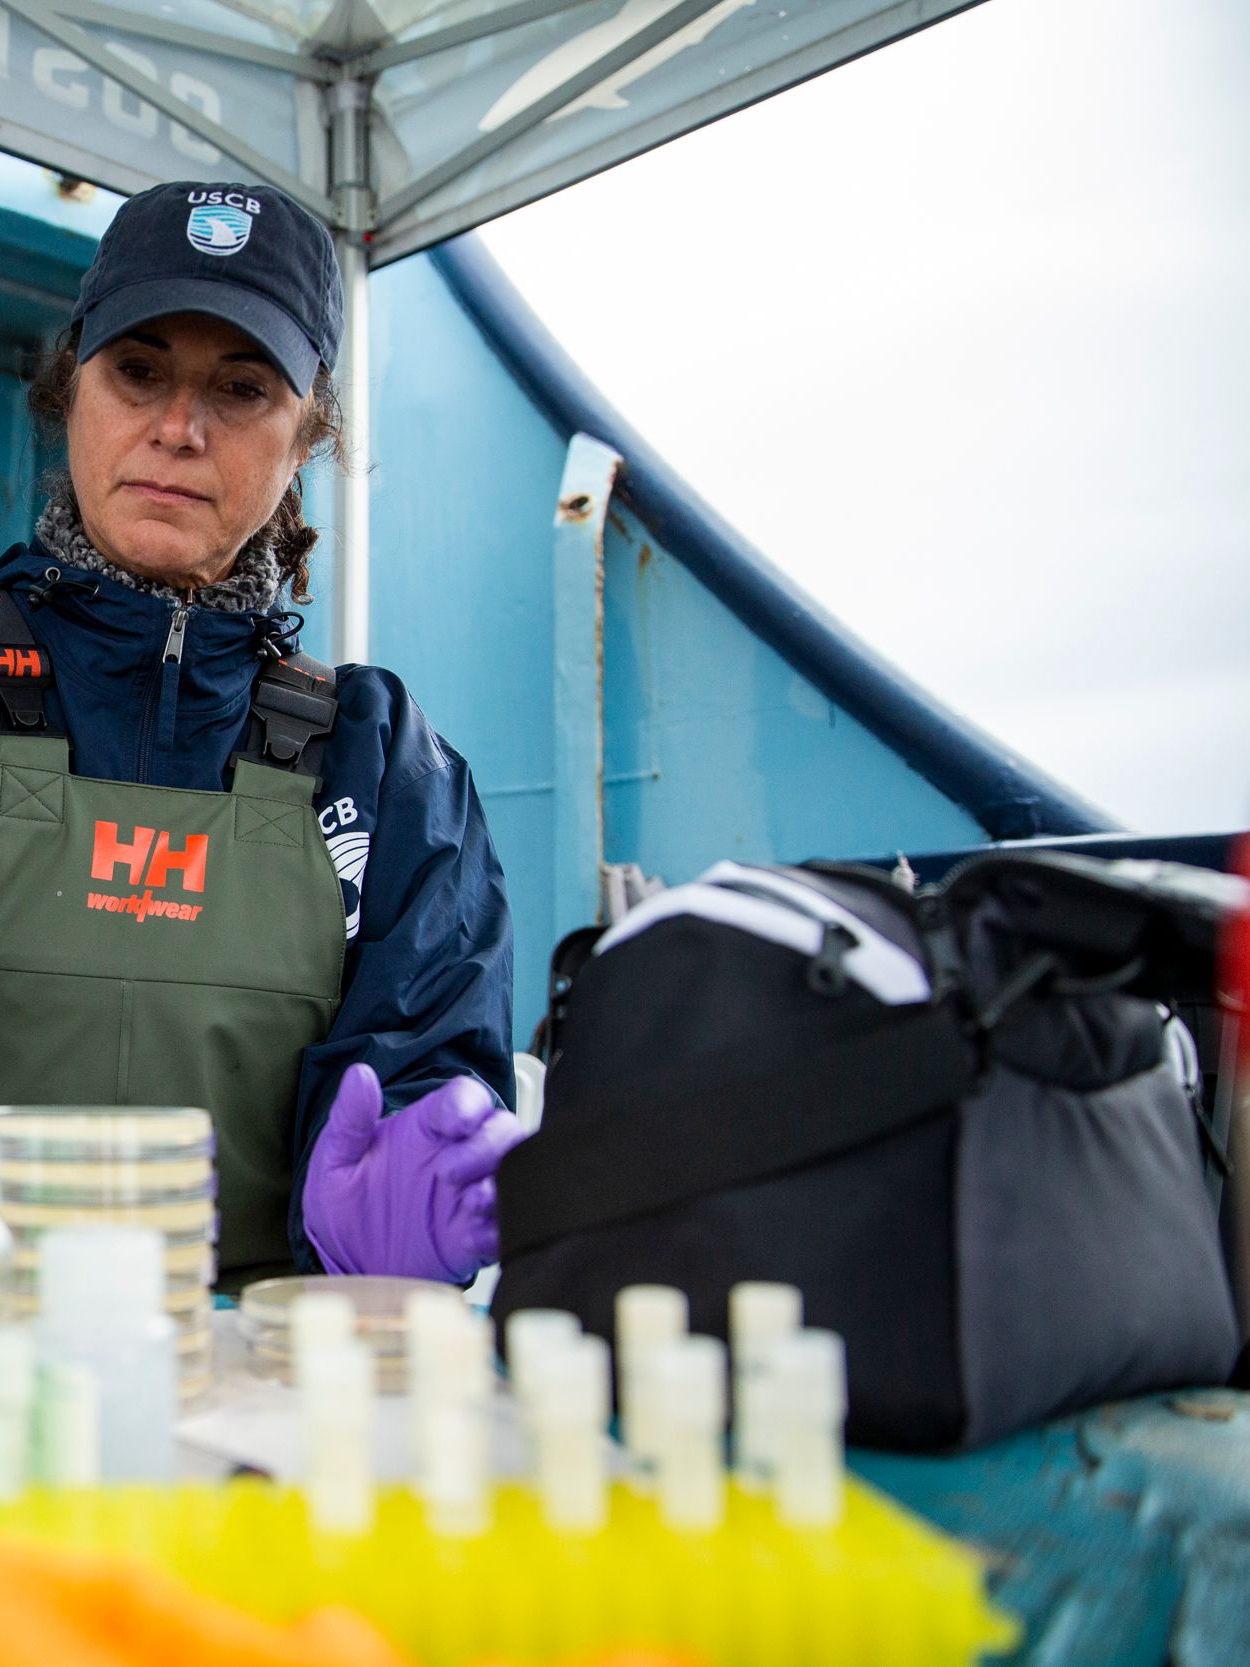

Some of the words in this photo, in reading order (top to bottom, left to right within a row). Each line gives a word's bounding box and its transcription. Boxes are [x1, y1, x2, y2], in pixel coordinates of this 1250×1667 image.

[187, 191, 261, 214] USCB
[318, 796, 359, 835] CB
[91, 820, 209, 892] HH
[87, 889, 203, 923] workwear
